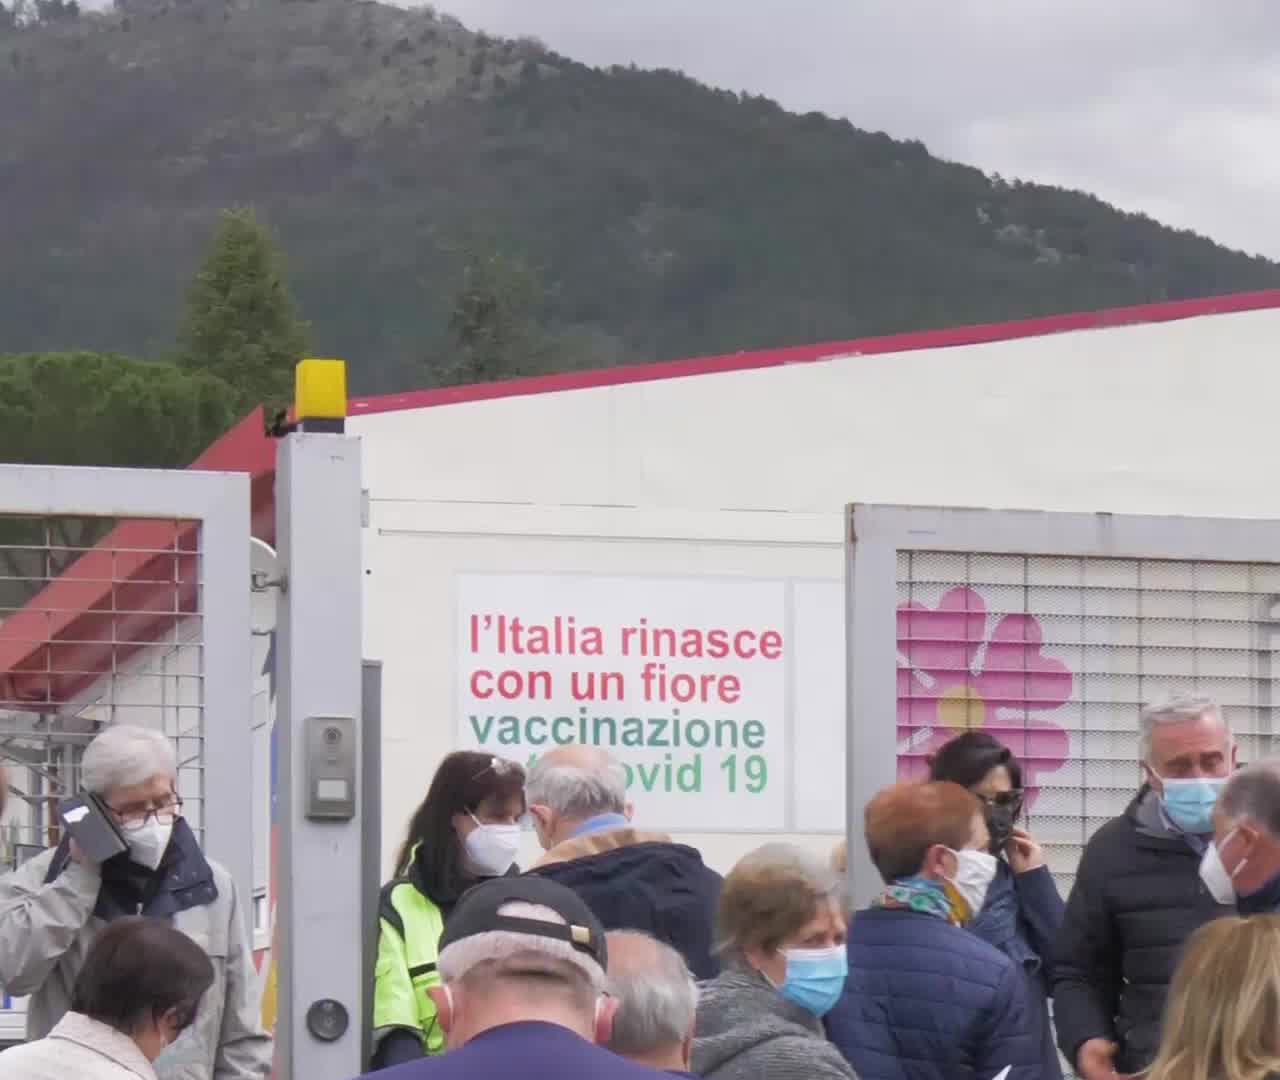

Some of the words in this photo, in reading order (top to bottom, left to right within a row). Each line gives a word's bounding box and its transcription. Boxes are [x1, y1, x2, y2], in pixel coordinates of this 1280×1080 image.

[470, 614, 605, 658] l'Italia
[621, 617, 784, 661] rinasce
[470, 668, 553, 702] con
[570, 669, 625, 702] un
[640, 662, 742, 705] fiore
[470, 707, 766, 750] vaccinazione
[621, 753, 702, 793] vid
[720, 754, 769, 793] 19
